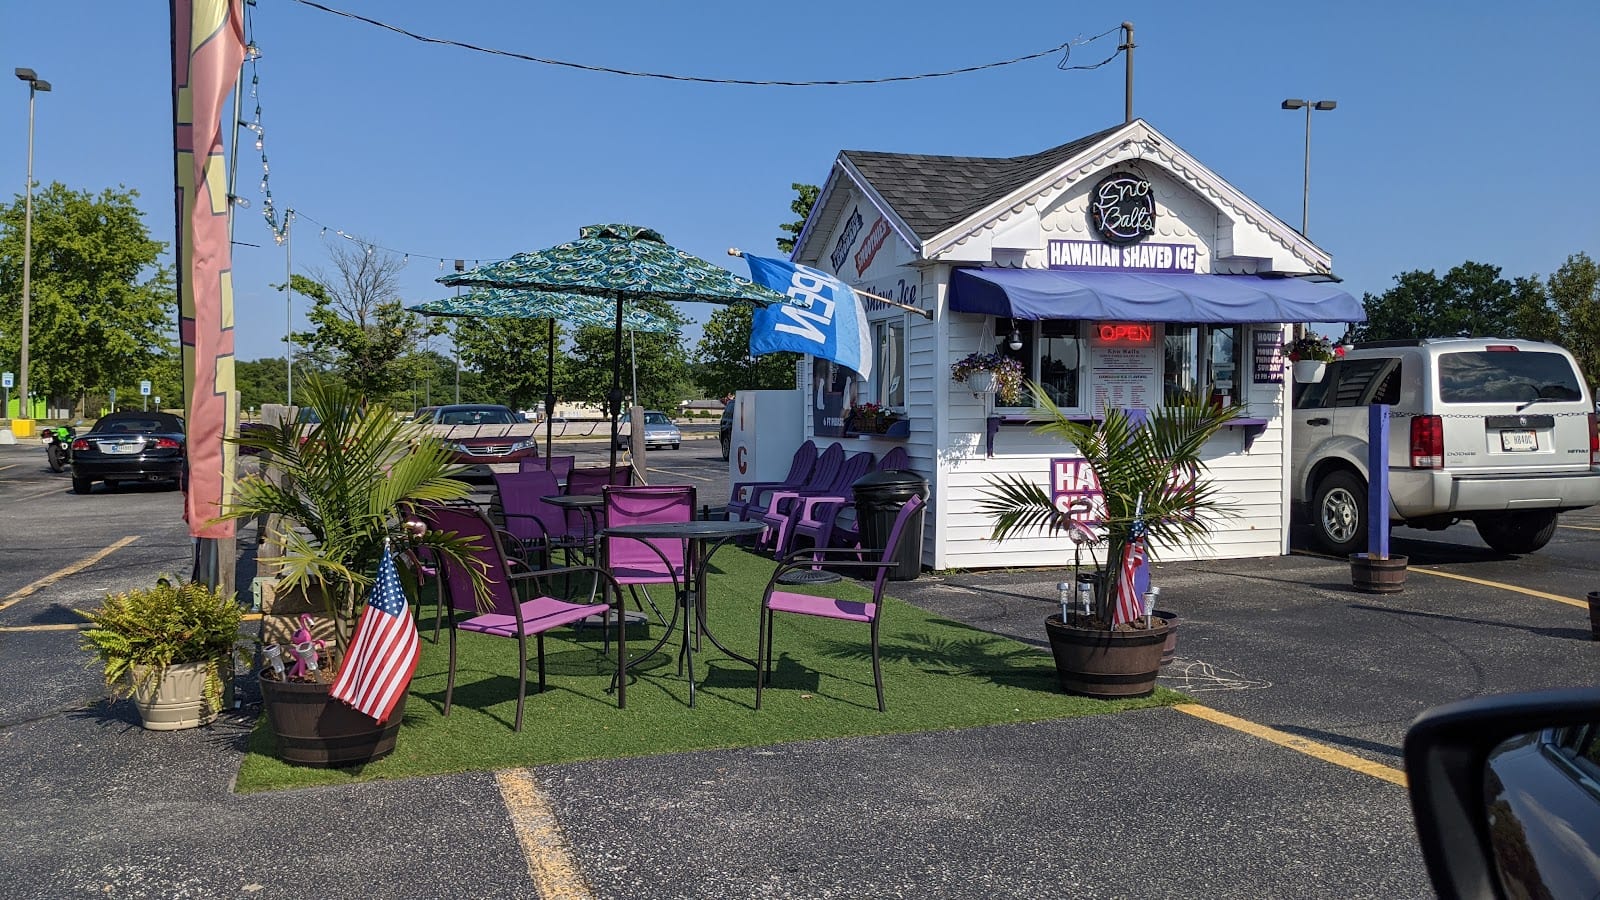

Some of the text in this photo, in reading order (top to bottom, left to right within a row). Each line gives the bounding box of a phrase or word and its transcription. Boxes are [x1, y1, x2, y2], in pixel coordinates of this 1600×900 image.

[1093, 181, 1151, 208] Sno
[1050, 242, 1195, 270] HAWAIIAN SHAVED ICE
[897, 279, 917, 305] Ice
[1100, 325, 1152, 341] OPEN
[1257, 332, 1281, 342] HOURS
